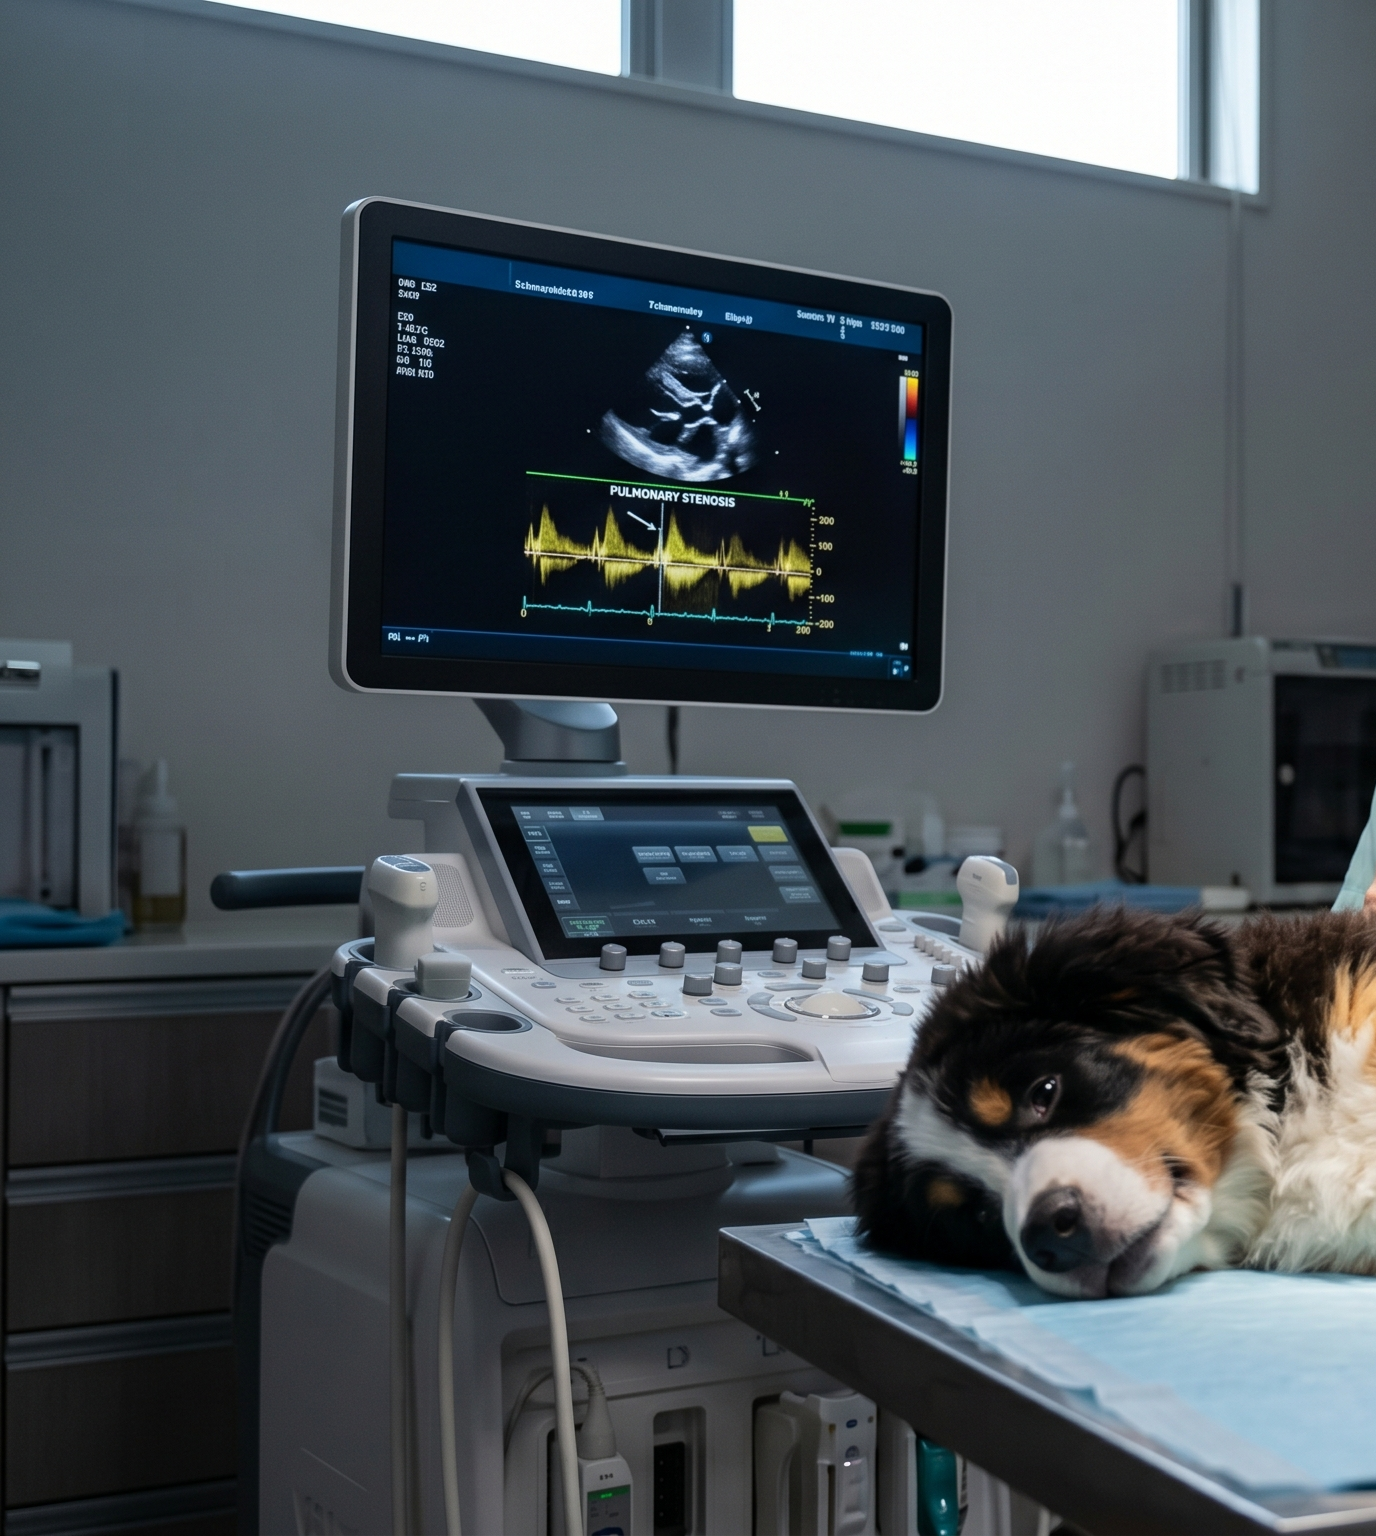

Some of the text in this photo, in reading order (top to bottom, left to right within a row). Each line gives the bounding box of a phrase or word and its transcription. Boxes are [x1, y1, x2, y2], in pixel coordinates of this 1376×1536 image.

[609, 485, 736, 508] PULMONARY STENOSIS
[818, 516, 835, 526] 200
[815, 567, 822, 576] 0
[520, 608, 527, 618] 0
[795, 625, 811, 635] 200
